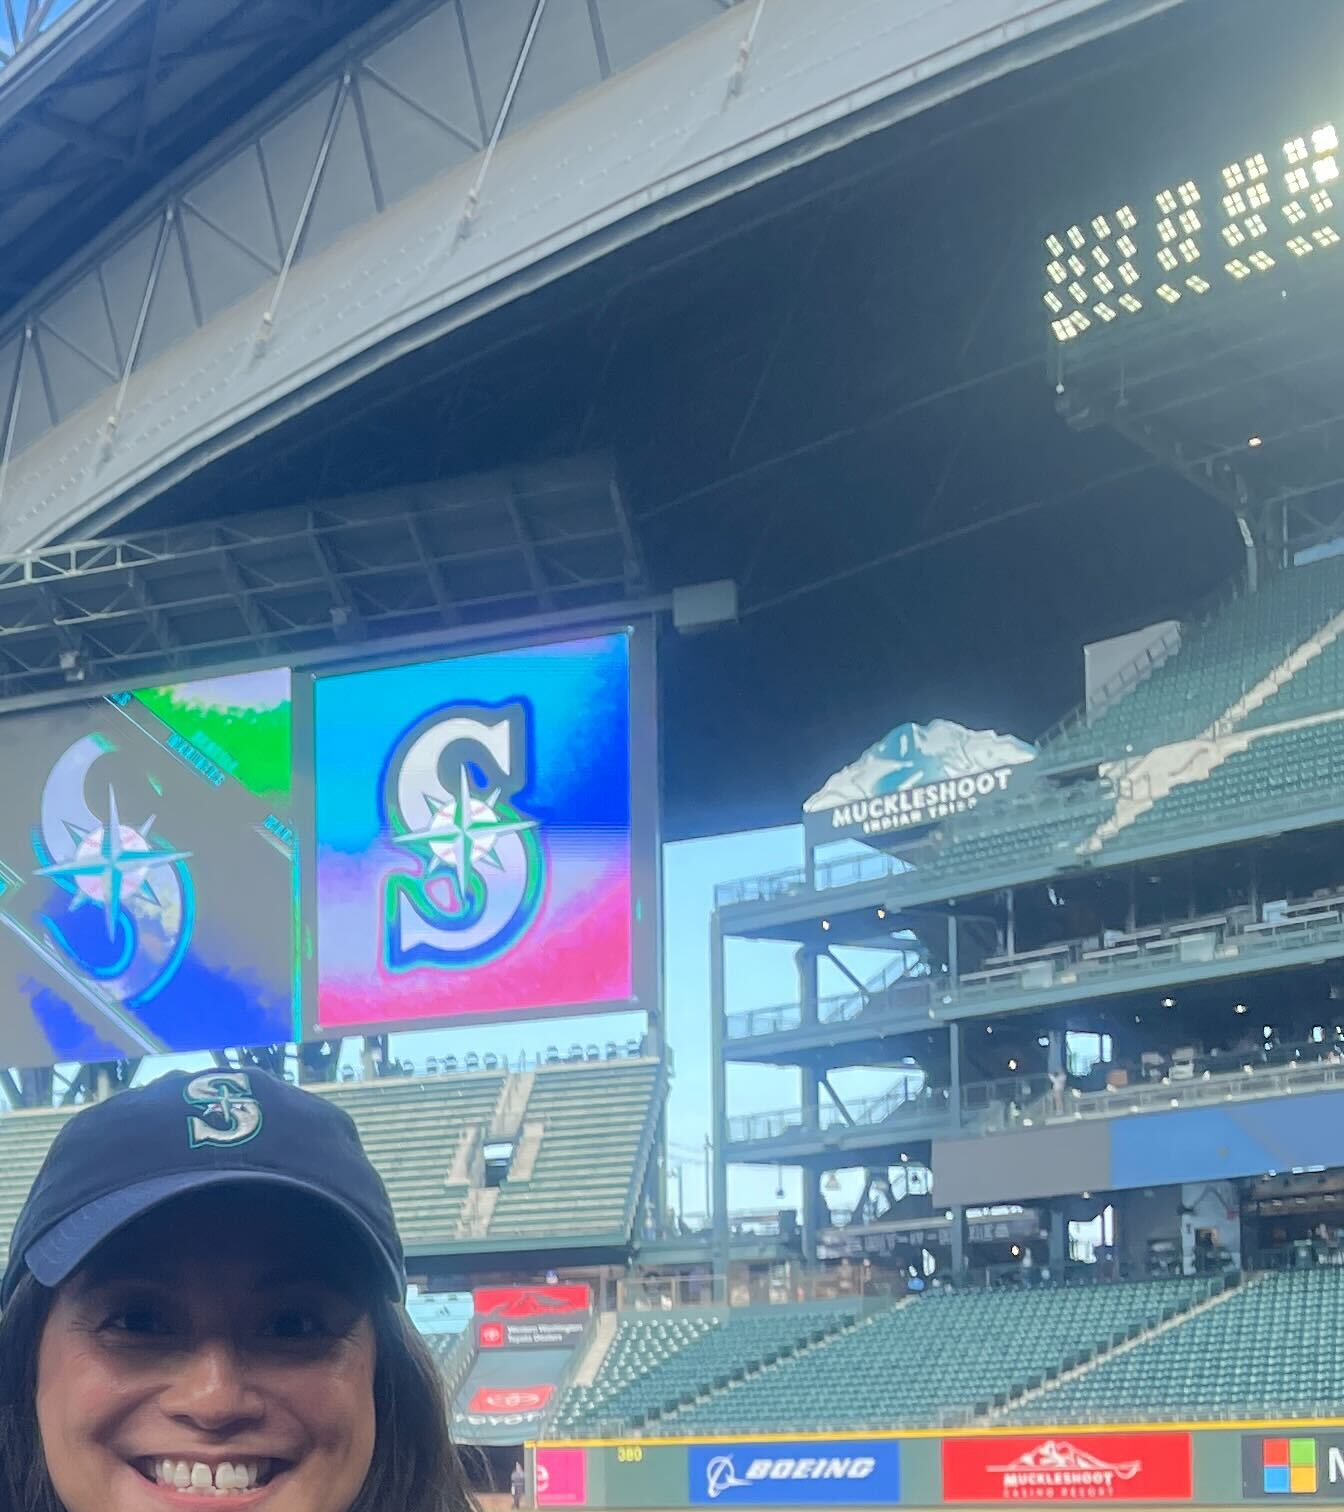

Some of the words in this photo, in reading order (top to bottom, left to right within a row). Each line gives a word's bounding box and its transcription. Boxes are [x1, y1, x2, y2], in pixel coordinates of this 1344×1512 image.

[832, 768, 1012, 828] MUCKLESHOOT
[863, 809, 922, 834] INDIAN
[745, 1457, 876, 1479] BOEING
[1003, 1471, 1113, 1487] MUCKLESHOOT
